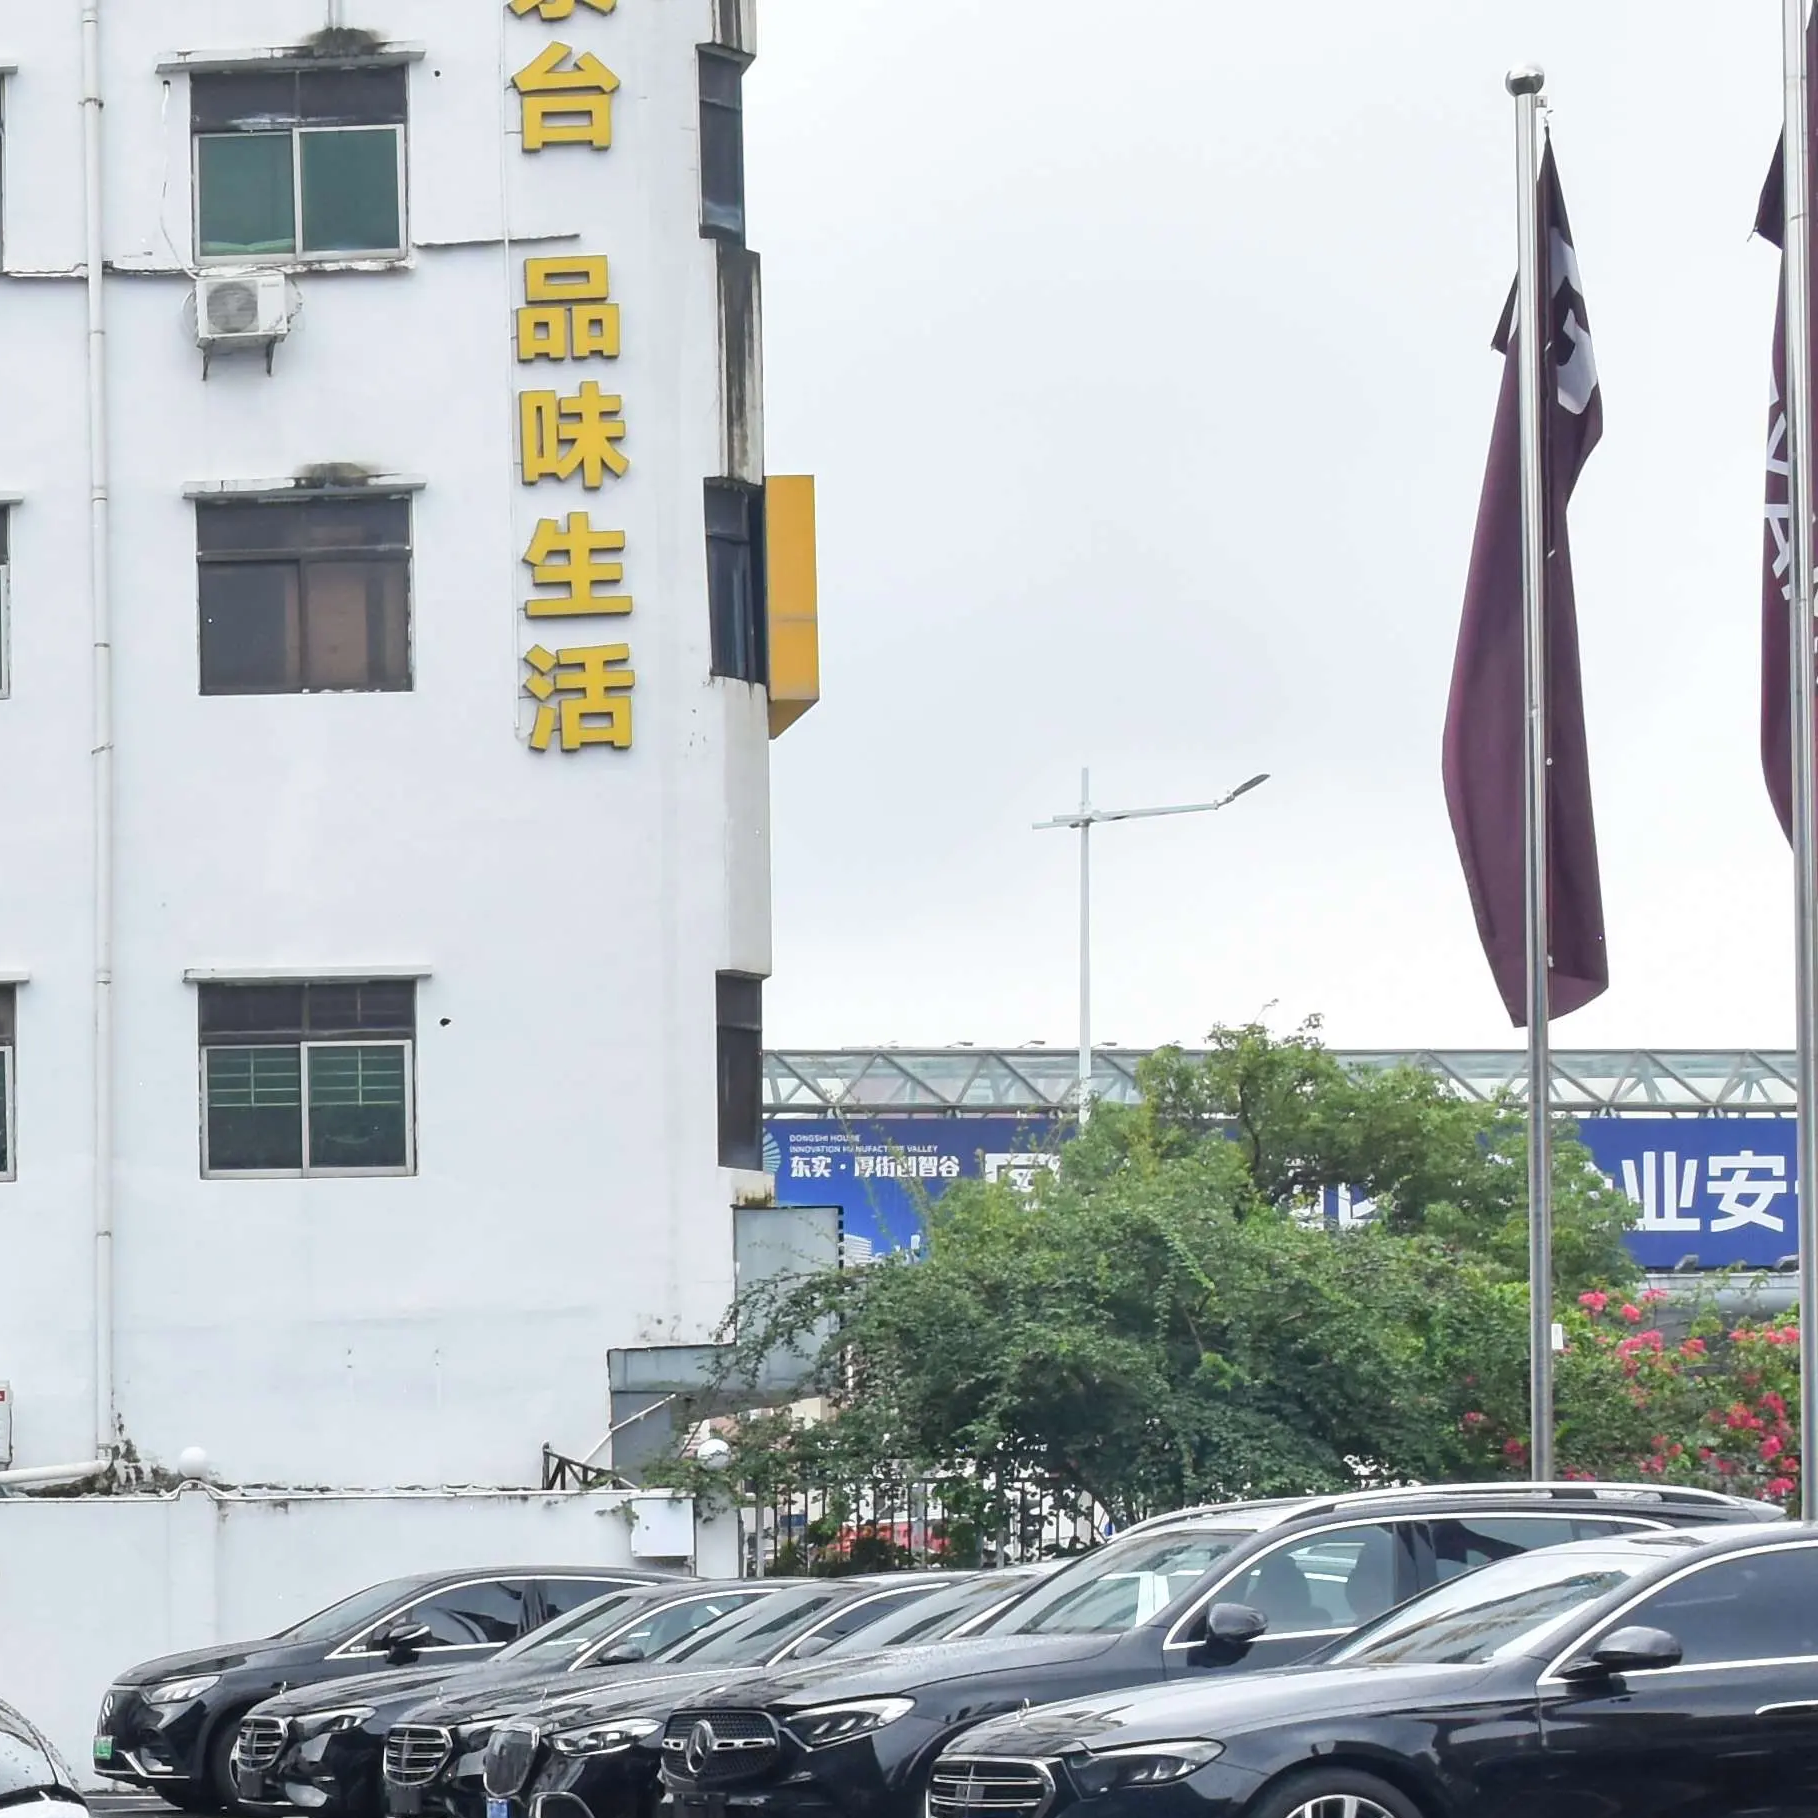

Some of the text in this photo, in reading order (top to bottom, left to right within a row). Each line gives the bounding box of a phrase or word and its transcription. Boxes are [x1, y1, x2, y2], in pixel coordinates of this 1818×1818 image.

[507, 0, 635, 751] 台 品味生活
[789, 1145, 840, 1153] INNOVATION
[907, 1145, 938, 1153] VALLEY
